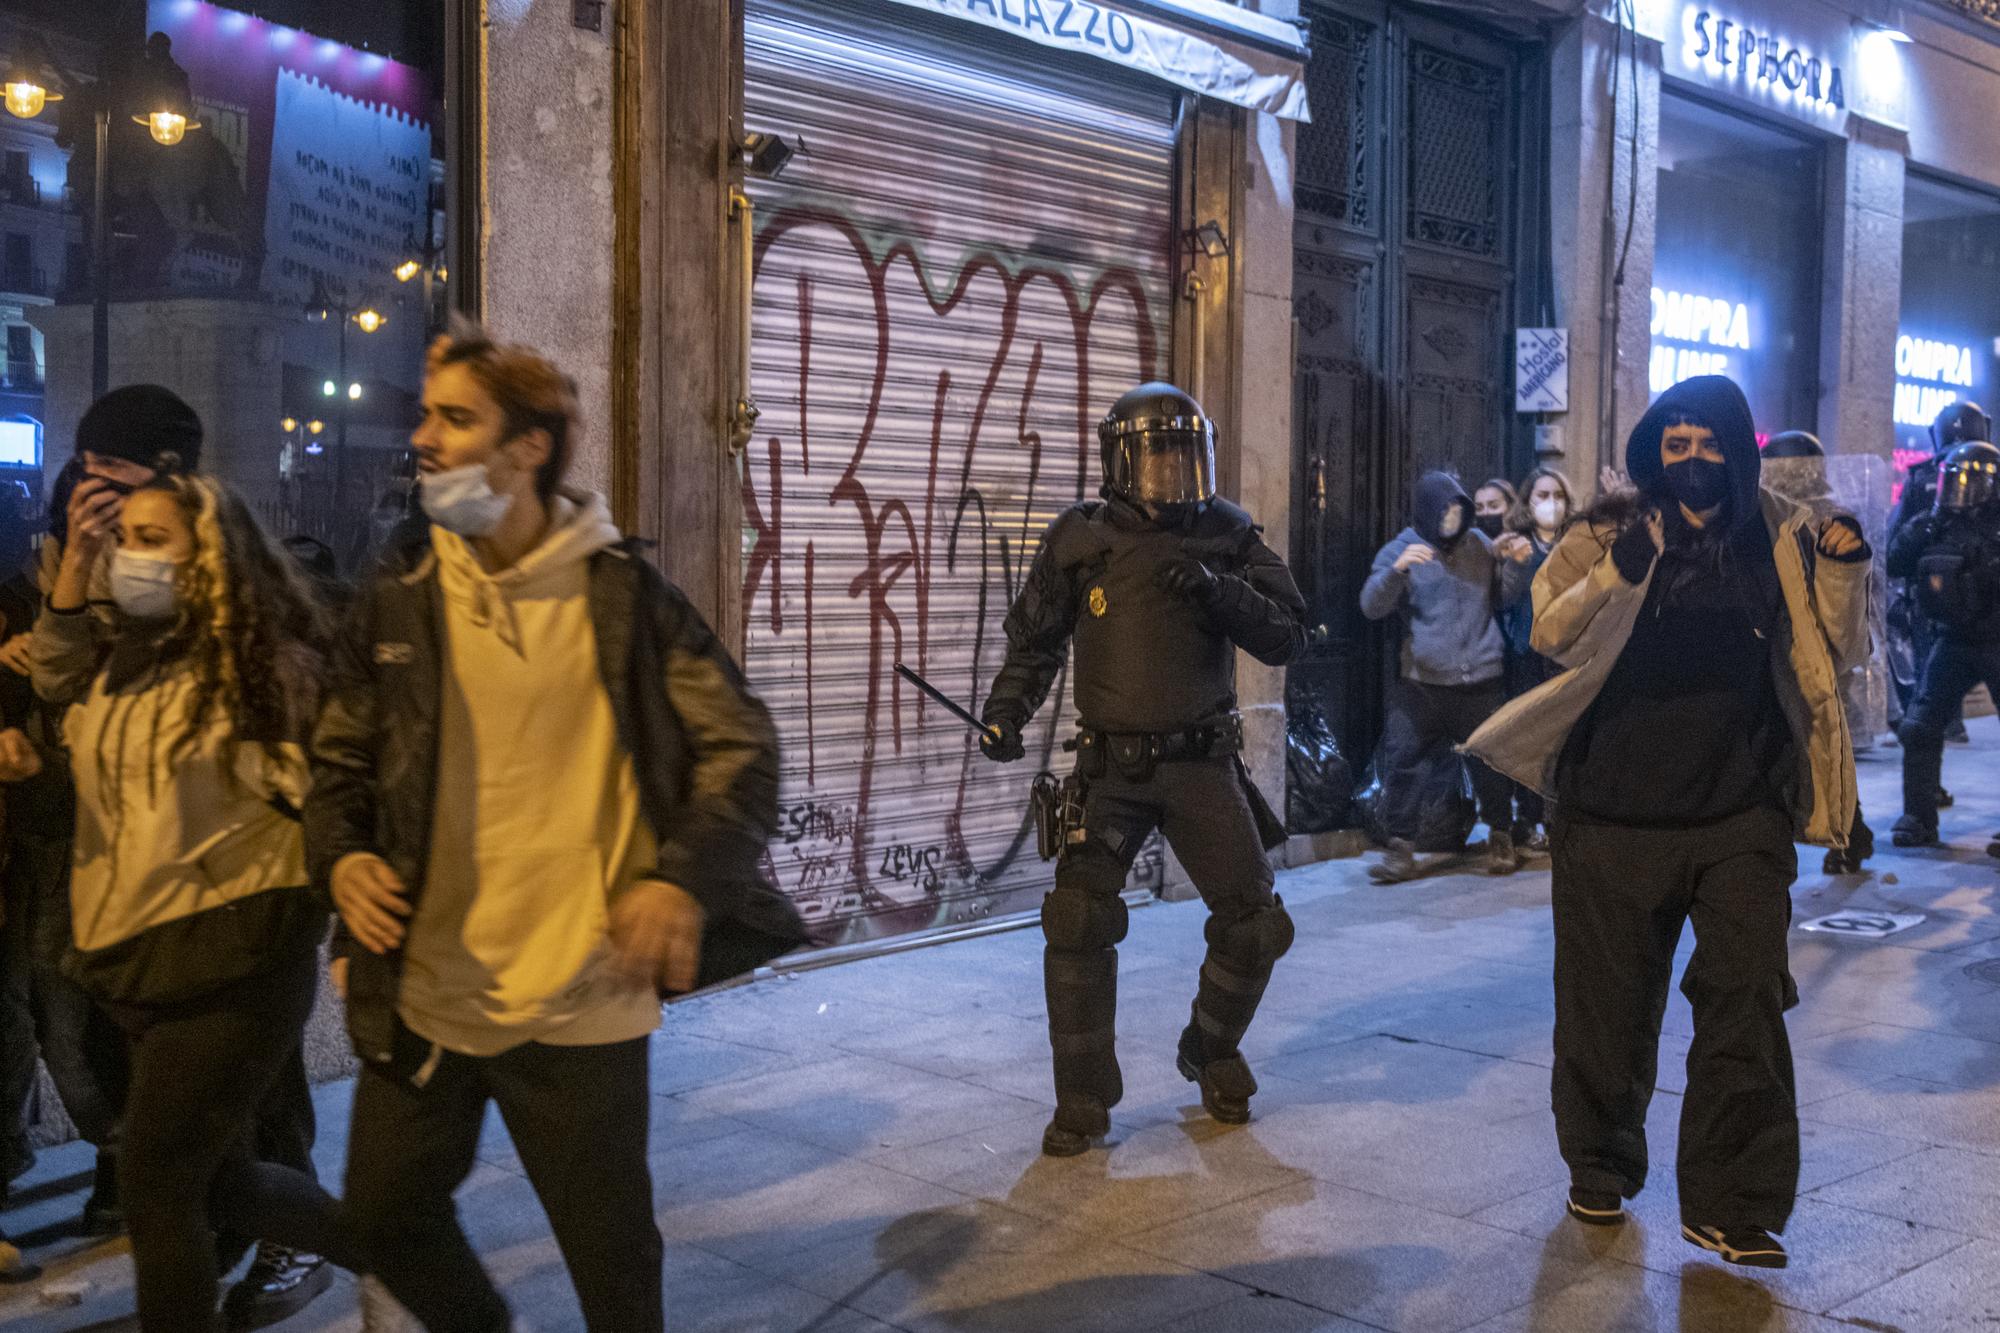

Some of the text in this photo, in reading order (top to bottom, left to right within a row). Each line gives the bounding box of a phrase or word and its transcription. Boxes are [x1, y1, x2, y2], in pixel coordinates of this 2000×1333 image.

[941, 0, 1133, 54] LAZZO
[1694, 11, 1845, 109] SEPHORA
[1517, 351, 1566, 401] AMERICANO
[1518, 329, 1564, 375] Hostal
